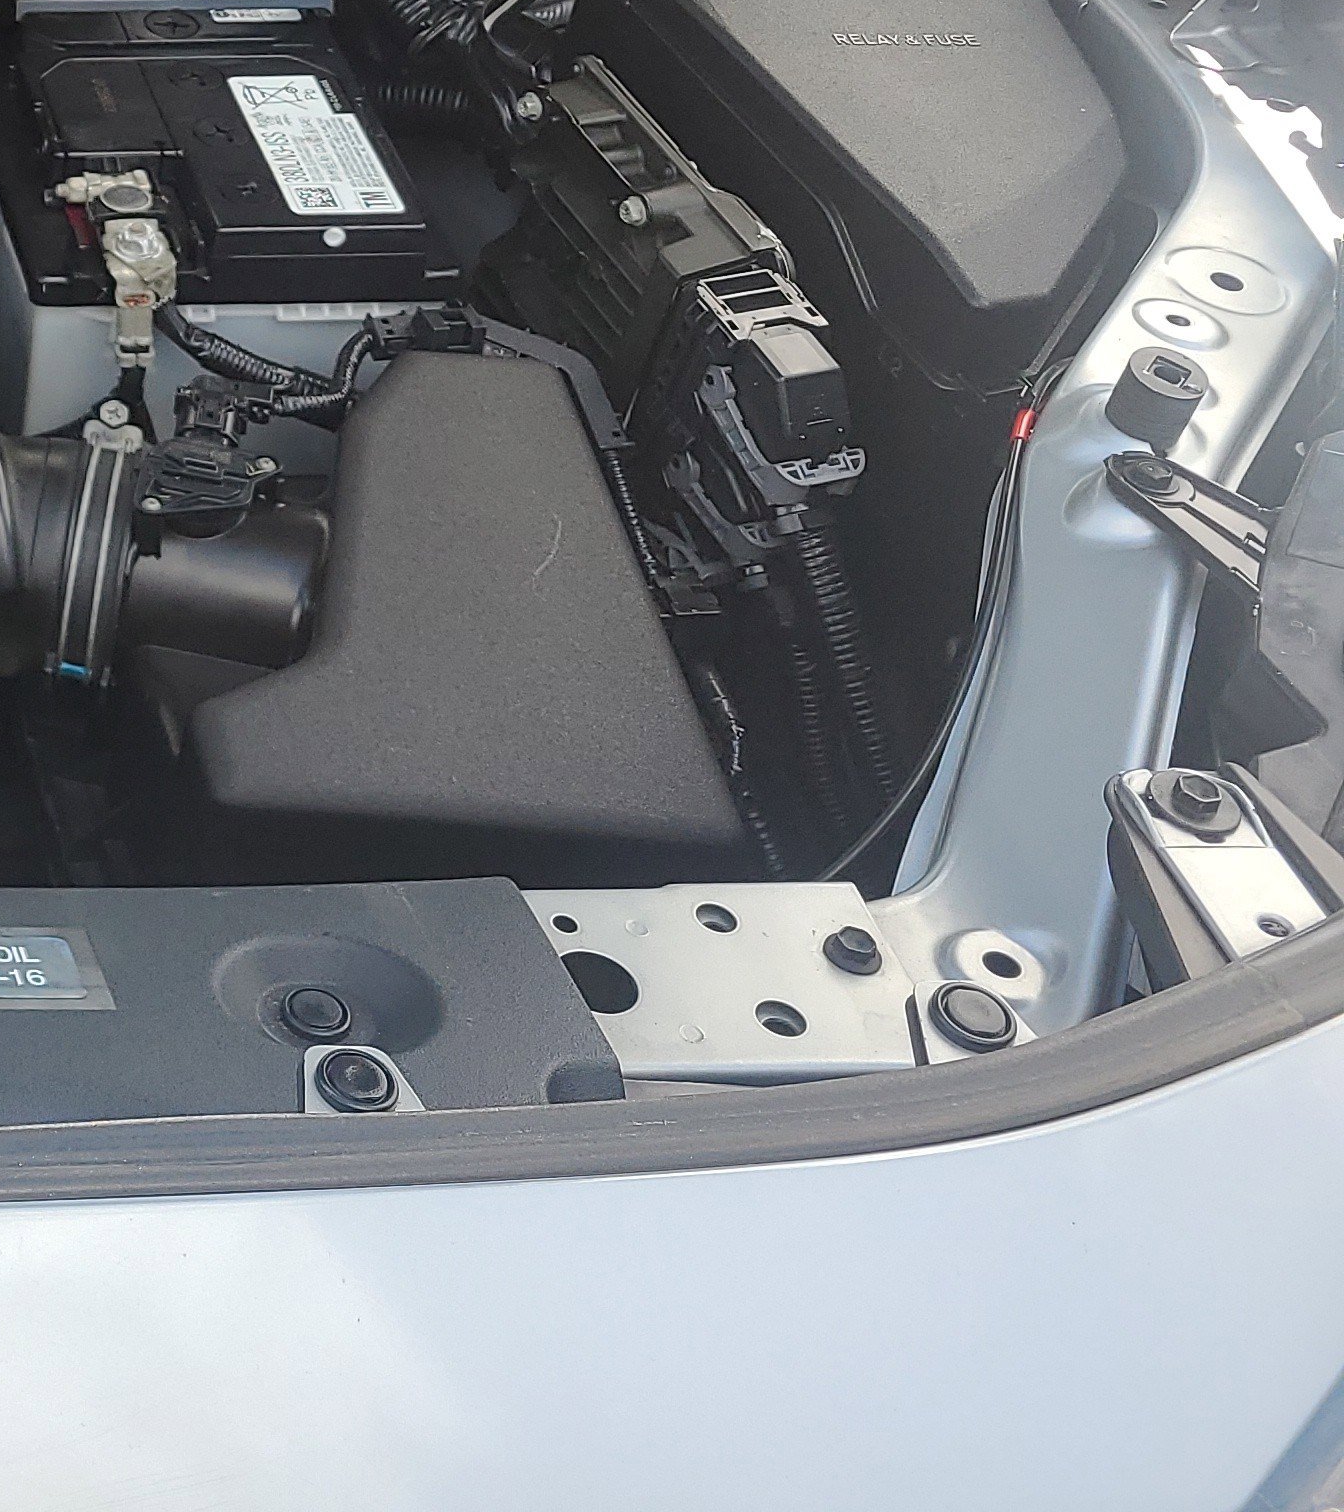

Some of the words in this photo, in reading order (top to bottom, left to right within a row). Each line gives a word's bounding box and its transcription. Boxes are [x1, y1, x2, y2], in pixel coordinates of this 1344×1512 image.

[832, 33, 900, 46] RELAY
[905, 33, 921, 46] &
[923, 33, 981, 47] FUSE
[359, 191, 390, 207] TM
